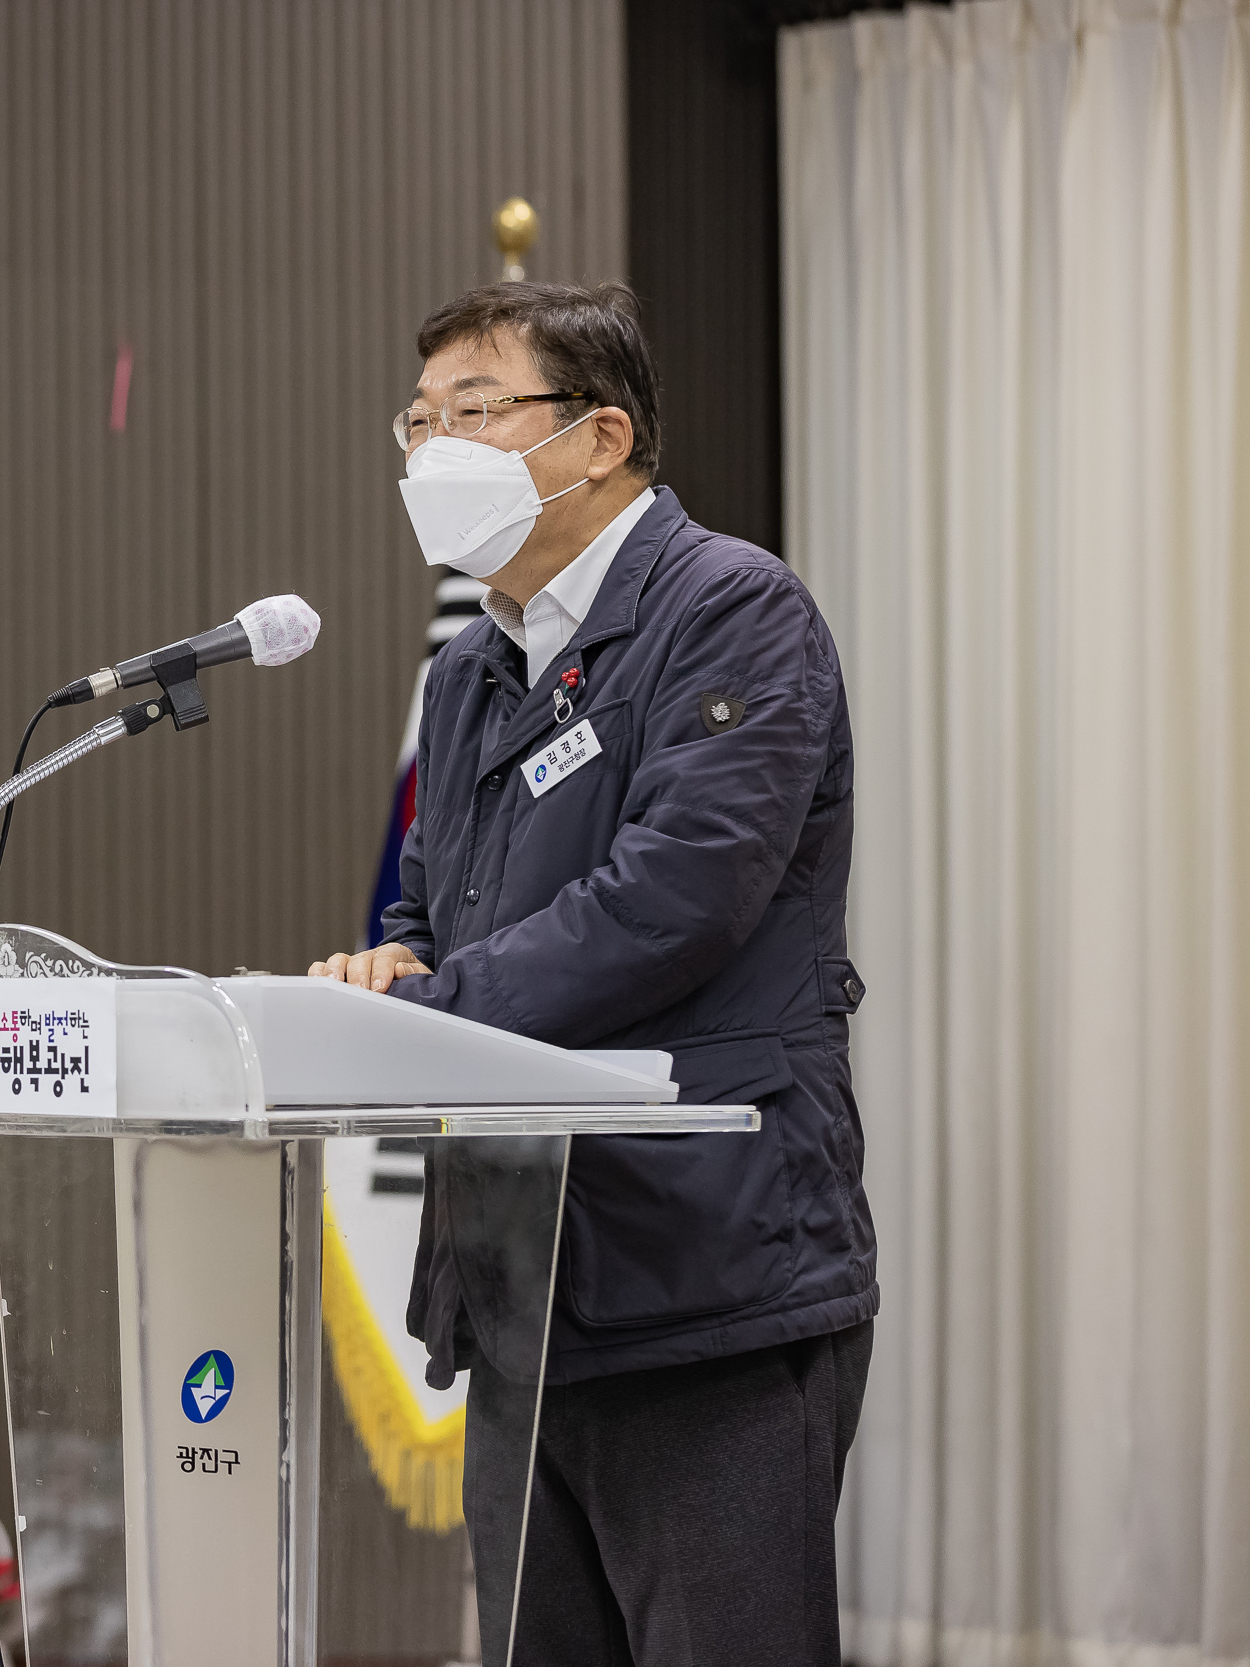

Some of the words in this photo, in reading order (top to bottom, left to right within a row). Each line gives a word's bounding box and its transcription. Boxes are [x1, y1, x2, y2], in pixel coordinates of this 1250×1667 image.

[557, 748, 587, 773] 광진구청장
[0, 1008, 42, 1043] 소통하며
[44, 1009, 90, 1043] 발전하는
[0, 1039, 90, 1098] 행복광진
[176, 1445, 241, 1475] 광진구
